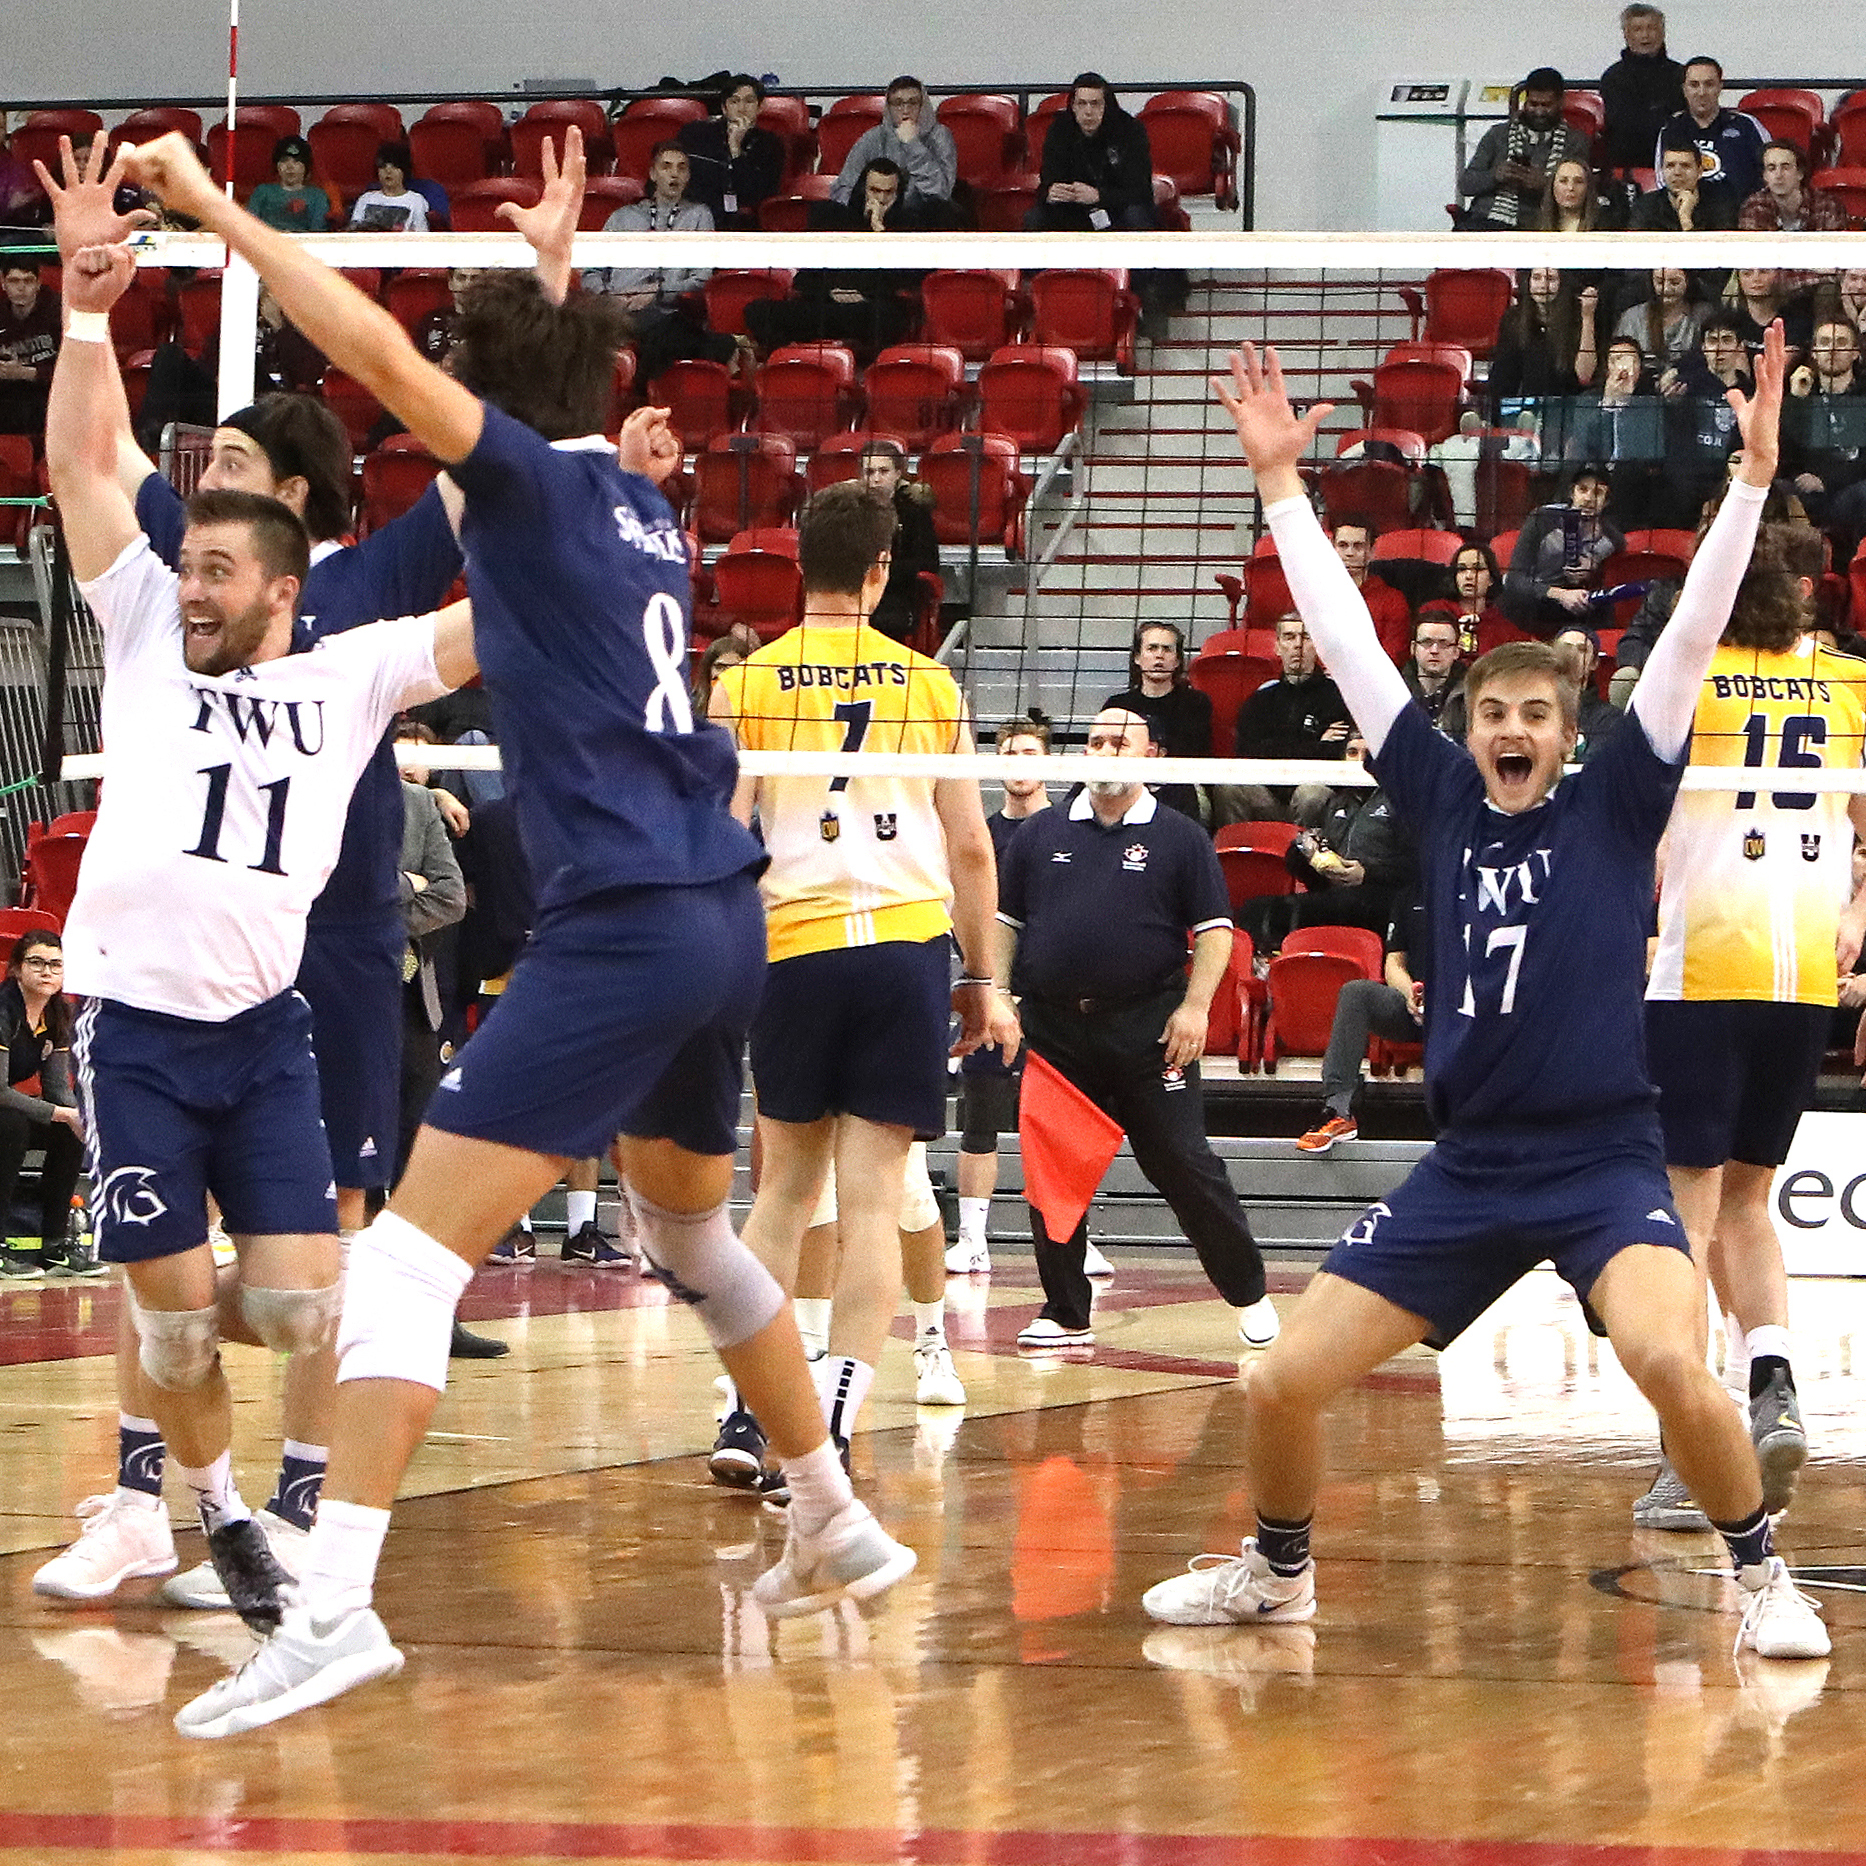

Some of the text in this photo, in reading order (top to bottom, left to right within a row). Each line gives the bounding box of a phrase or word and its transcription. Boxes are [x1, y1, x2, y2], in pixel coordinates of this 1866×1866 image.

[643, 592, 694, 734] 8
[777, 662, 906, 691] BOBCATS
[1712, 674, 1831, 703] BOBCATS
[188, 683, 325, 756] TWU
[828, 700, 872, 792] 7
[1735, 714, 1826, 810] 16
[182, 762, 291, 876] 11
